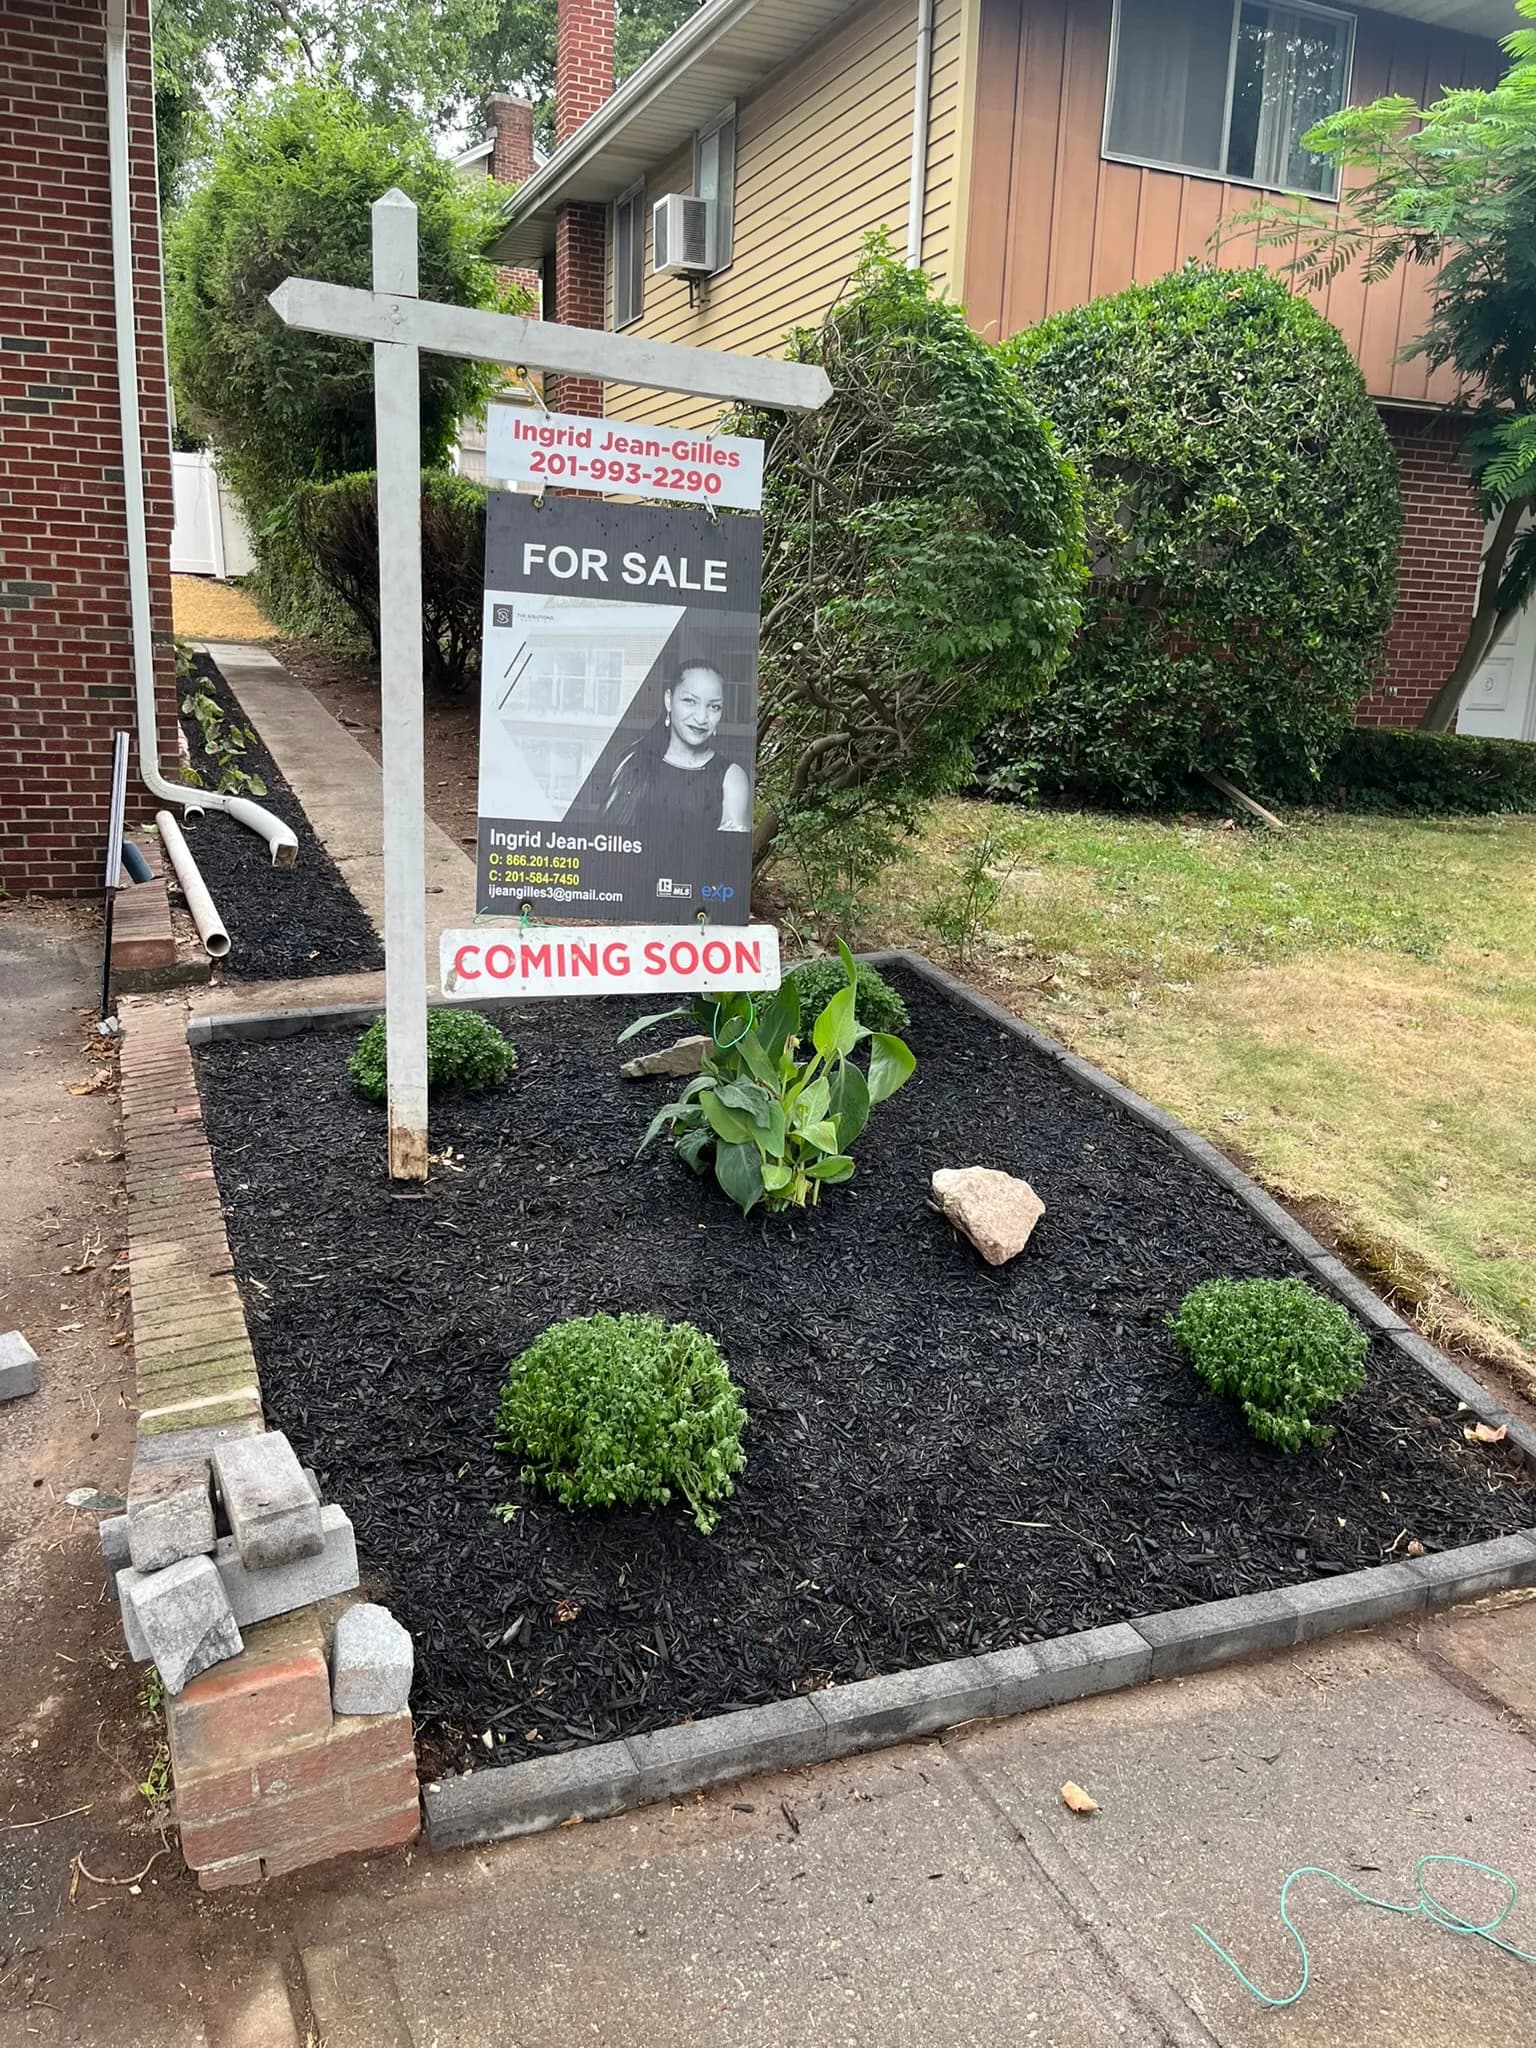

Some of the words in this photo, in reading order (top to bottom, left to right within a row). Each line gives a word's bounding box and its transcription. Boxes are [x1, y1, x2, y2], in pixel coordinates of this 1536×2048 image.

[514, 420, 592, 449] Ingrid
[600, 432, 740, 468] Jean-Gilles
[529, 451, 722, 495] 201-993-2290
[523, 543, 609, 582] FOR
[622, 552, 727, 593] SALE
[490, 828, 541, 850] Ingrid
[546, 832, 642, 853] Jean-Gilles
[489, 853, 503, 865] O:
[506, 854, 580, 869] 866.201.6210
[489, 870, 502, 882] C:
[505, 871, 580, 885] 201-584-7450
[488, 884, 623, 902] ijeangilles3@gmail.com
[673, 887, 690, 896] MLS
[454, 943, 630, 980] COMING
[644, 941, 761, 975] SOON
